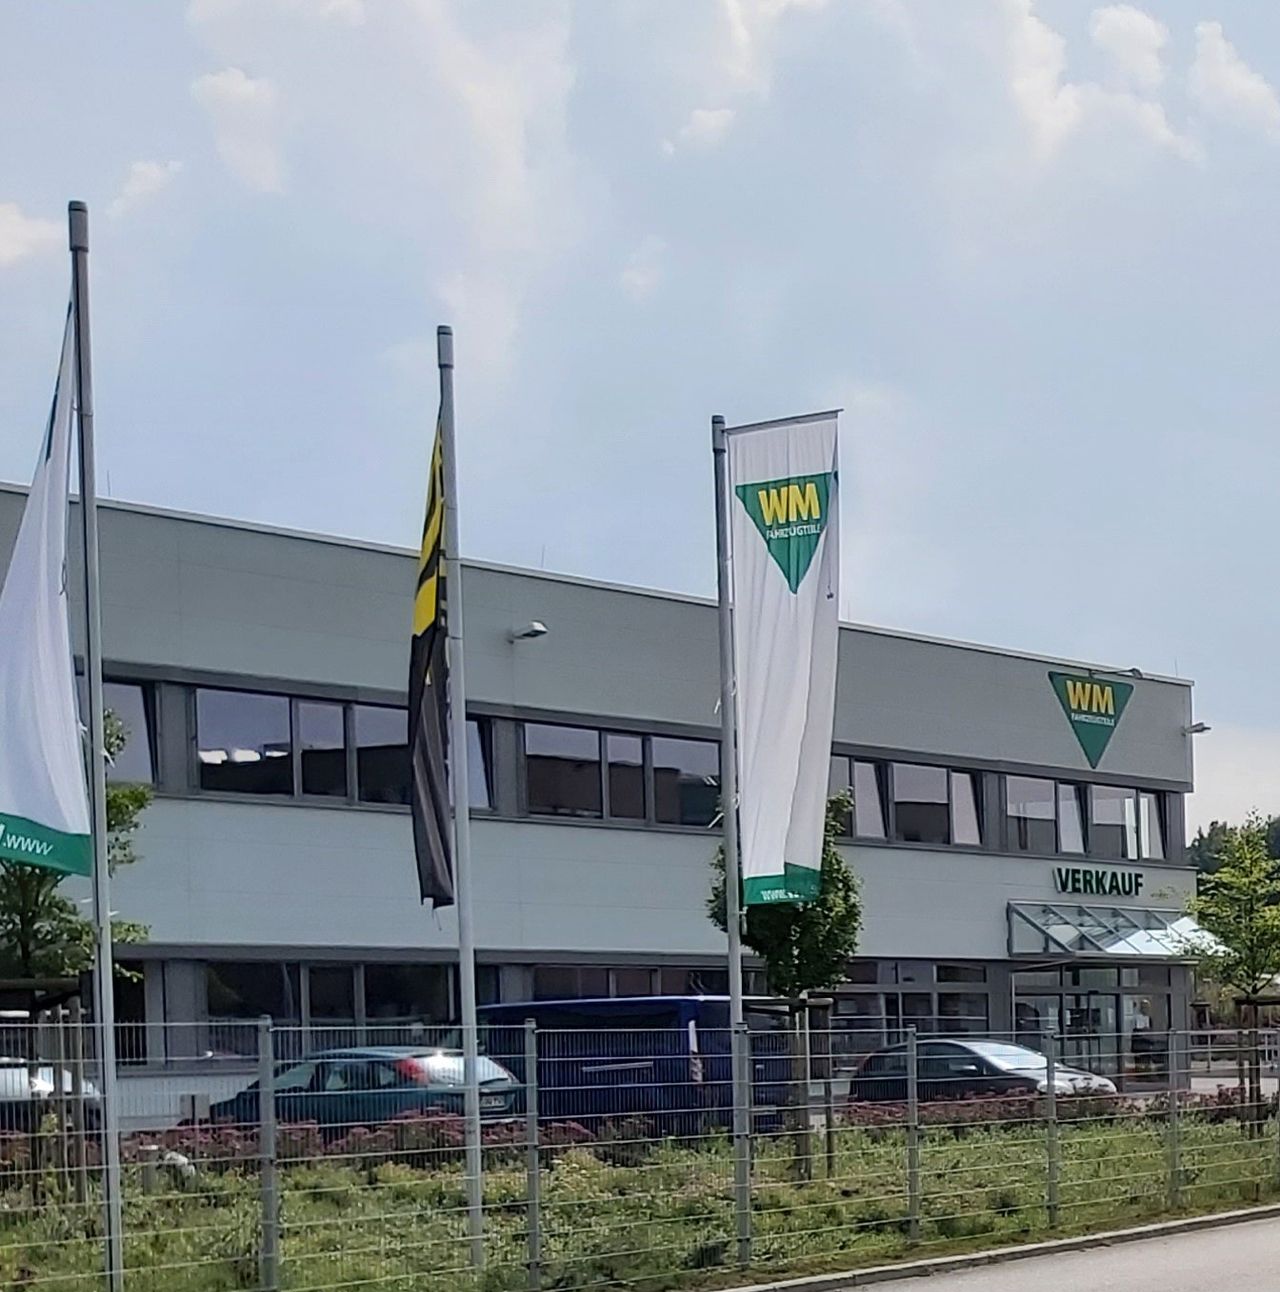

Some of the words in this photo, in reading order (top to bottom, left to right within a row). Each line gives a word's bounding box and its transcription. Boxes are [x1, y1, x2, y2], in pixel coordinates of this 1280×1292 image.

[758, 483, 820, 526] WM
[1066, 680, 1115, 715] WM
[1055, 867, 1144, 897] VERKAUF
